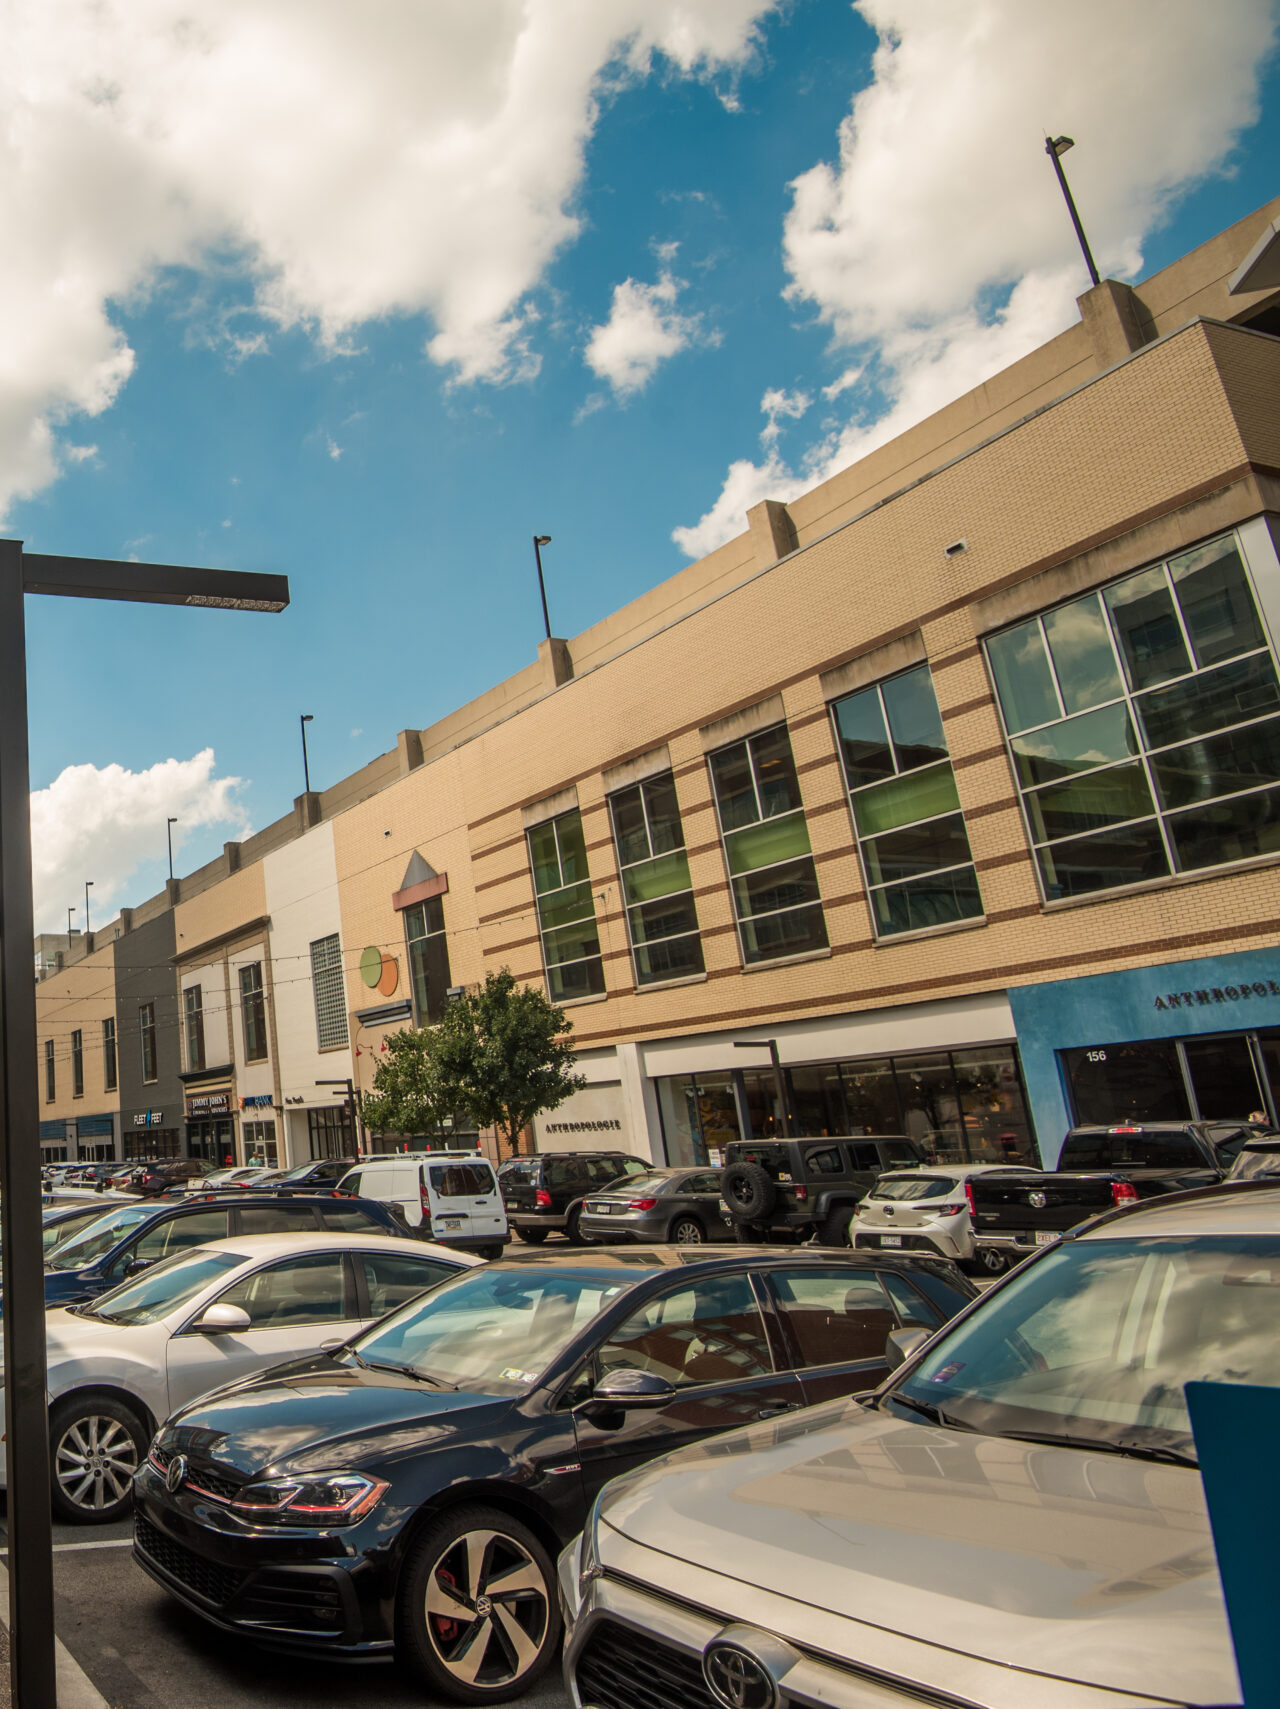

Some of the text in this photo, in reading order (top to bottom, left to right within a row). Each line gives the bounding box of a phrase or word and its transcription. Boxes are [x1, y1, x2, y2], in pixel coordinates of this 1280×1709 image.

[1086, 1050, 1107, 1062] 156
[134, 1112, 163, 1125] FLEET FEET
